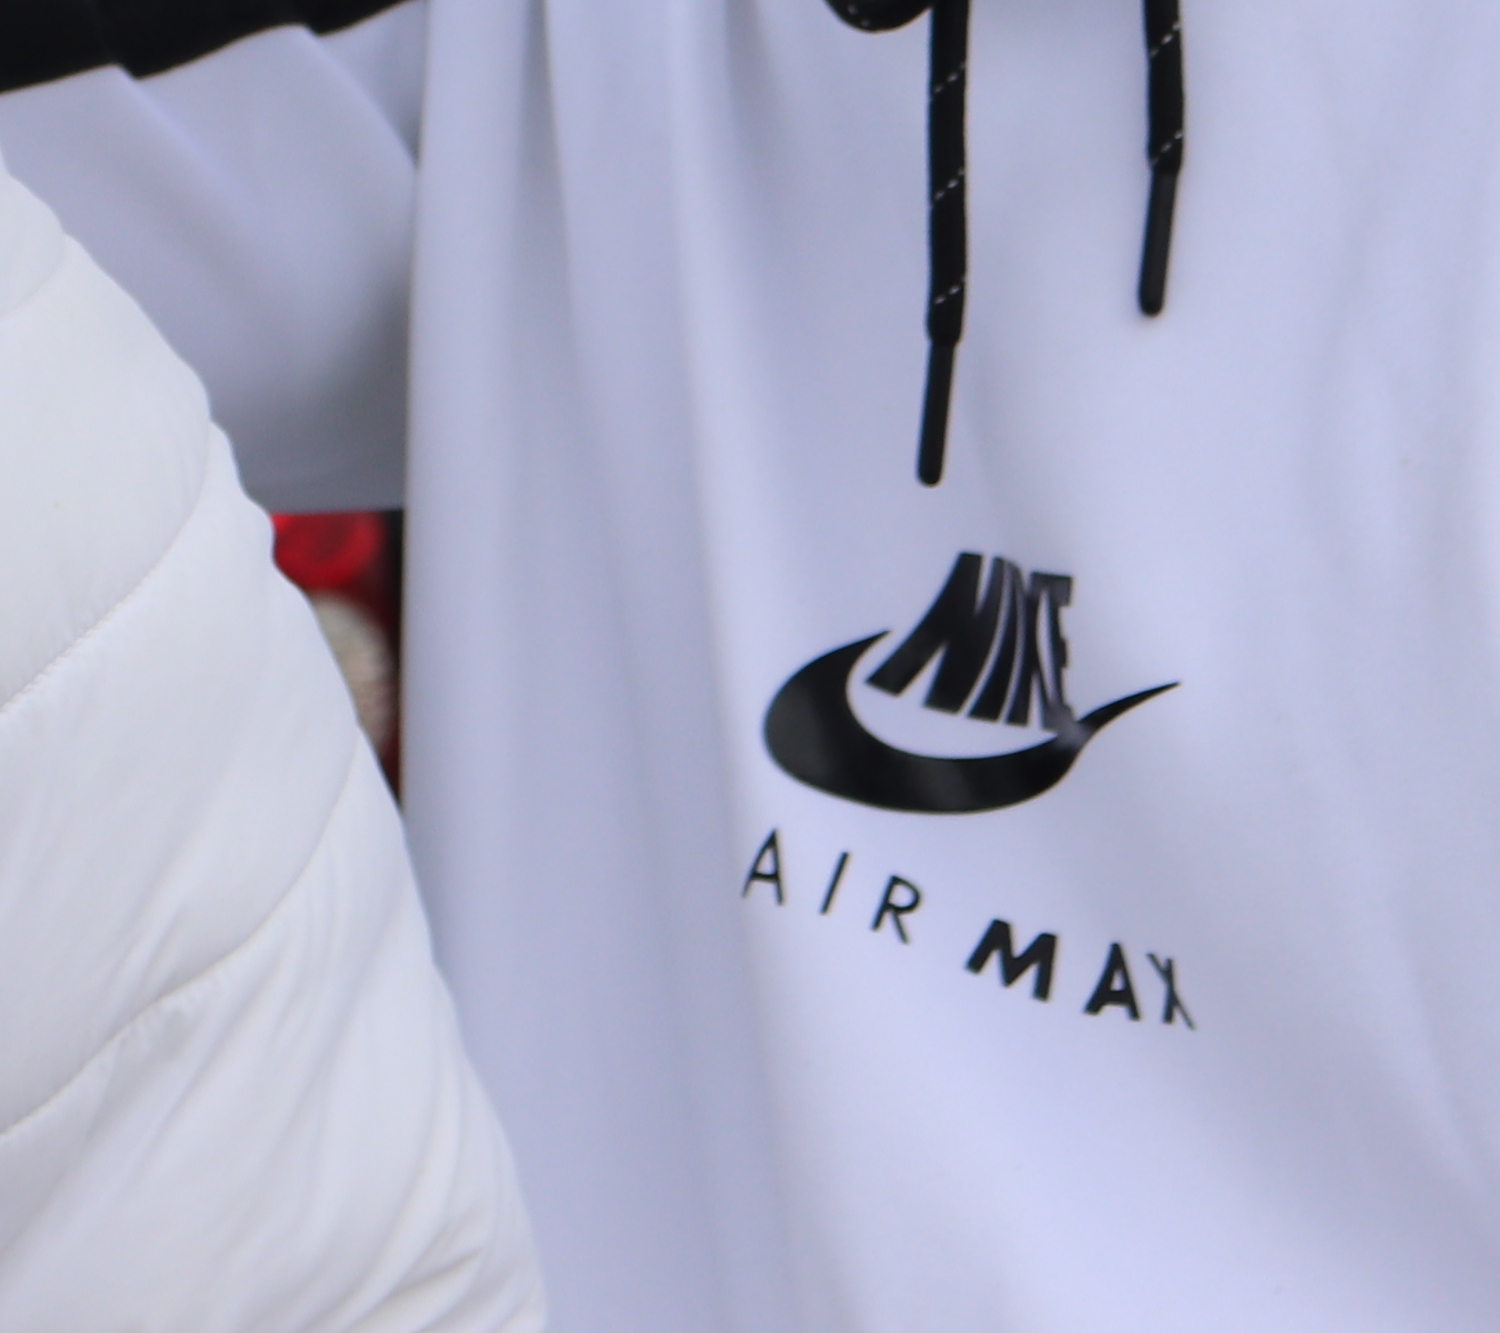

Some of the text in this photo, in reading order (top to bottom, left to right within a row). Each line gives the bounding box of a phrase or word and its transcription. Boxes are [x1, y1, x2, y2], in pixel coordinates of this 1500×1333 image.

[865, 550, 1075, 735] NIKE
[742, 829, 1195, 1031] AIR MAX
